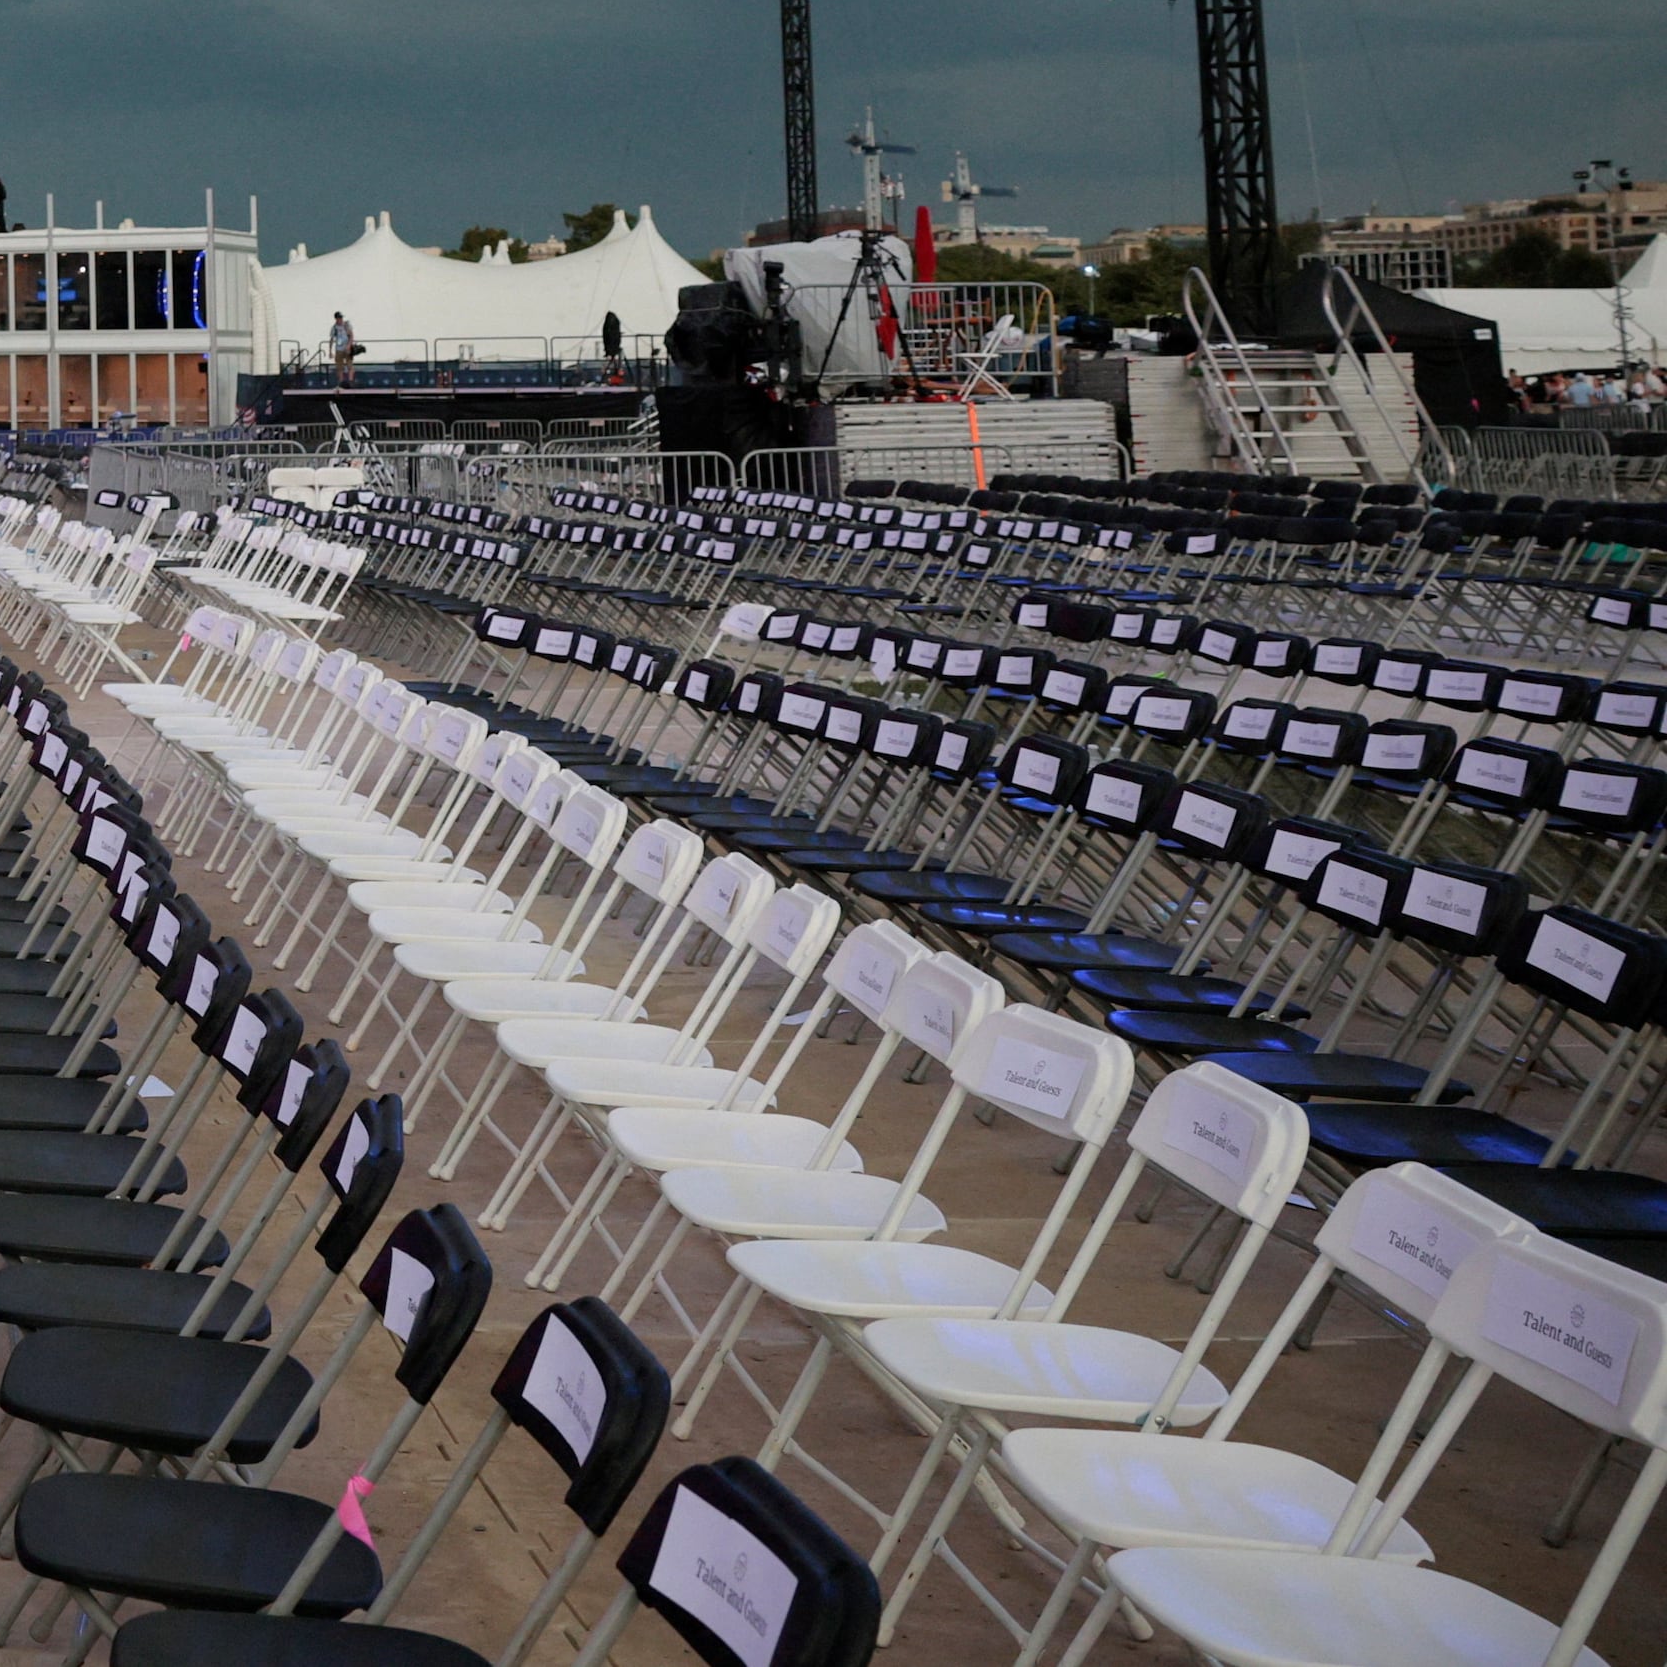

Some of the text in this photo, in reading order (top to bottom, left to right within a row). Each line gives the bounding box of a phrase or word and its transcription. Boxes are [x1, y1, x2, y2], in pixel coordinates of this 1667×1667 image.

[1005, 1070, 1062, 1097] Talent and Guests
[1193, 1121, 1215, 1143] Talent
[1389, 1230, 1420, 1260] Talent
[1419, 1246, 1437, 1270] and
[1523, 1310, 1612, 1369] Talent and Guests
[695, 1557, 727, 1599] Talent
